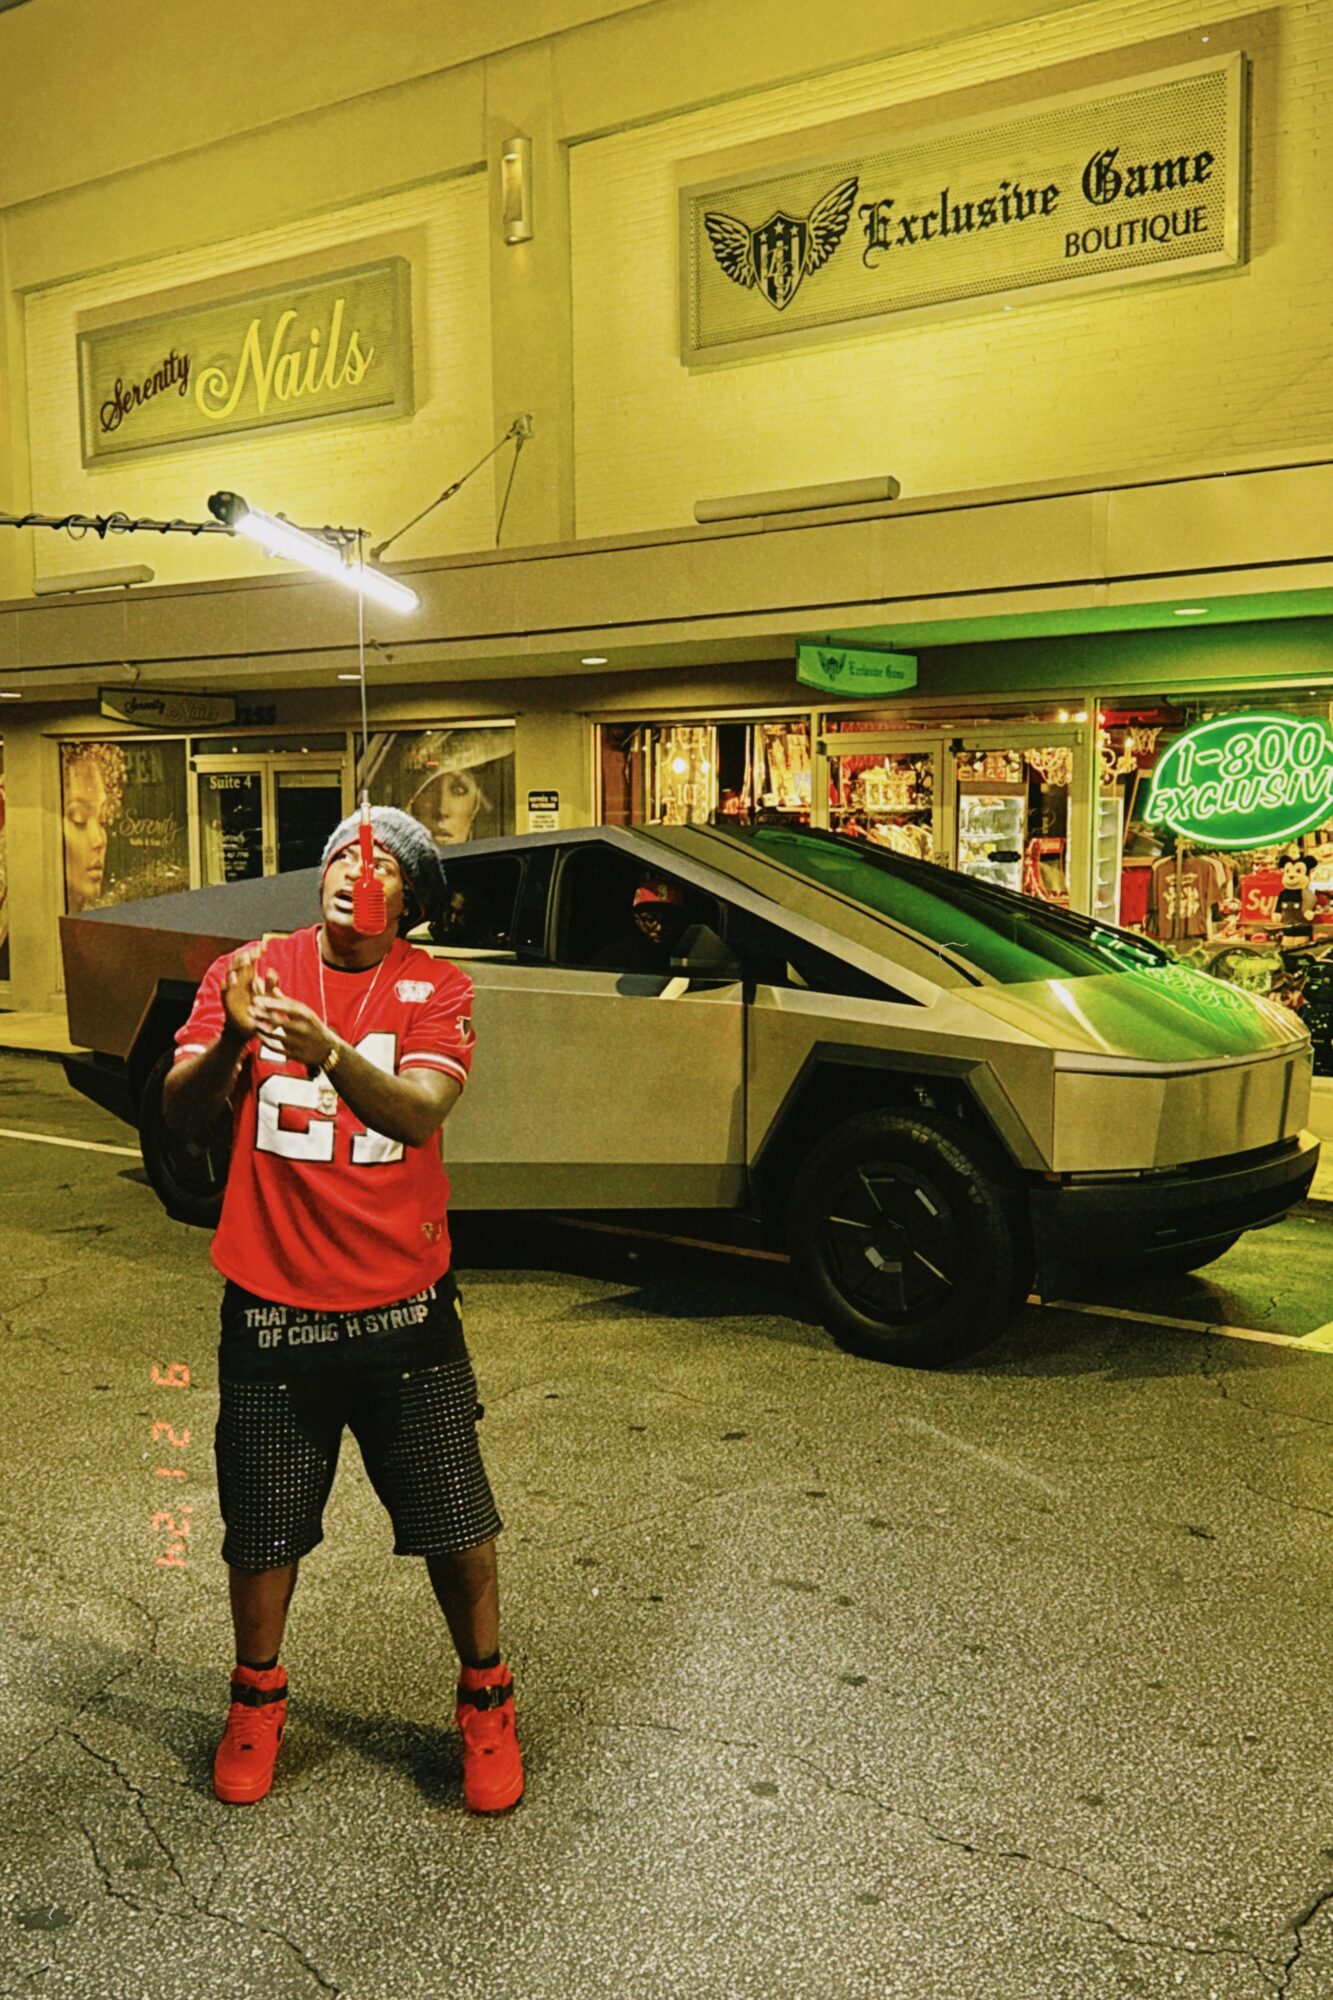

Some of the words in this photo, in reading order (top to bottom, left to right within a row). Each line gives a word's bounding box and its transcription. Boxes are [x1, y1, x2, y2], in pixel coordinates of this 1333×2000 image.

[857, 181, 1061, 270] Exclusive
[1080, 146, 1215, 208] Game
[1064, 204, 1209, 259] BOUTIQUE
[99, 347, 192, 434] Serenity
[194, 298, 375, 420] Nails
[209, 776, 241, 790] Suite
[244, 775, 252, 789] 4
[1177, 721, 1326, 787] 1-800
[255, 1025, 406, 1164] 21
[258, 1329, 283, 1349] OF
[365, 1304, 429, 1334] SYRUP
